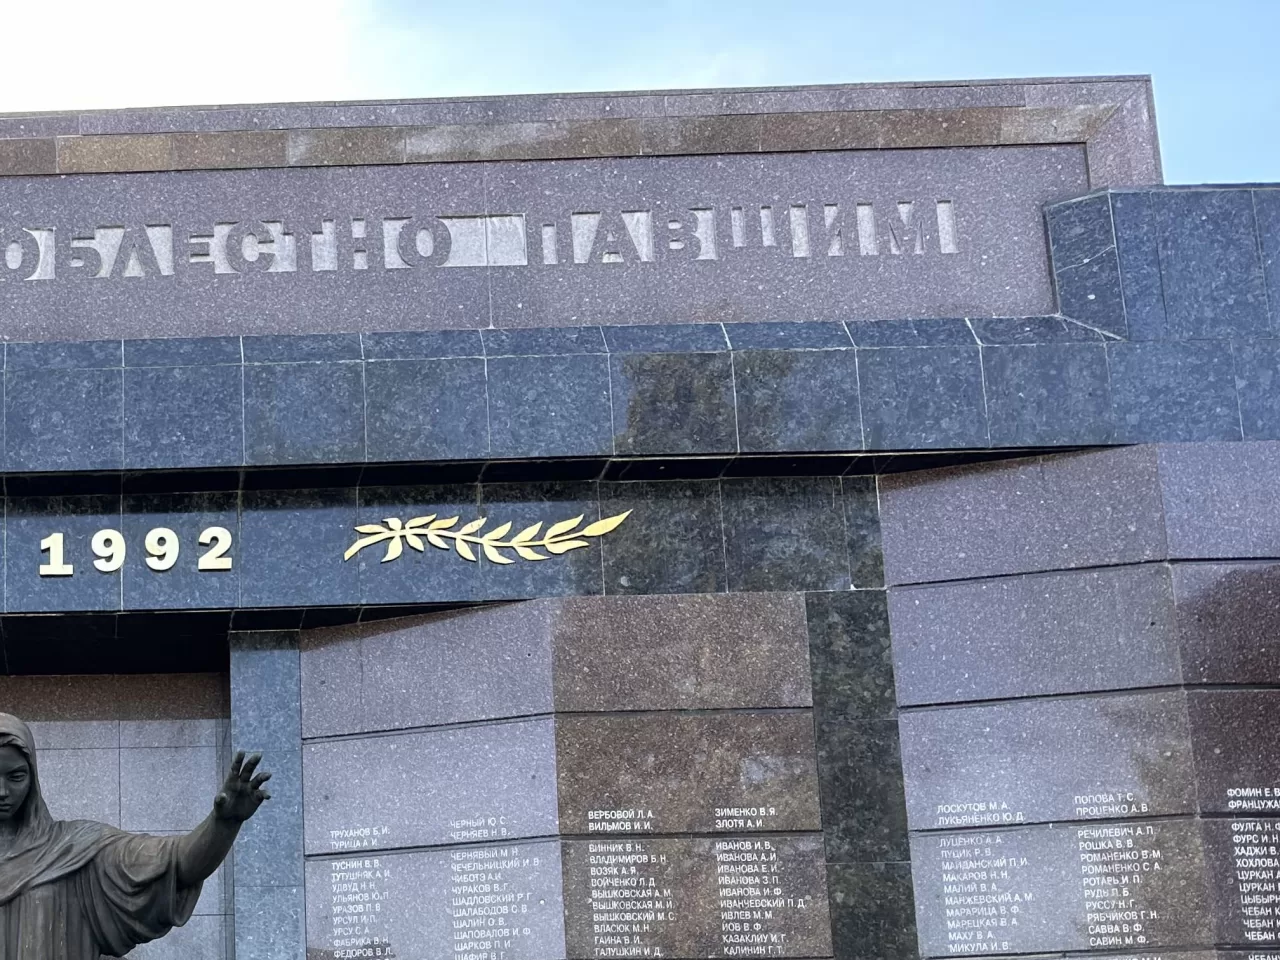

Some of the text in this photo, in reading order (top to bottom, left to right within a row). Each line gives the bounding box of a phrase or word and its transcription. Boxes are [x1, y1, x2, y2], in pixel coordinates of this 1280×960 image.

[39, 526, 233, 576] 1992
[1226, 788, 1262, 797] ФОМИН
[588, 810, 634, 820] ВЕРБОВОЙ
[714, 807, 757, 817] ЗИМЕНКО
[588, 821, 631, 831] ВИЛЬМОВ
[715, 819, 744, 829] ЗЛОТЯ
[718, 876, 760, 885] ИВАНОВА
